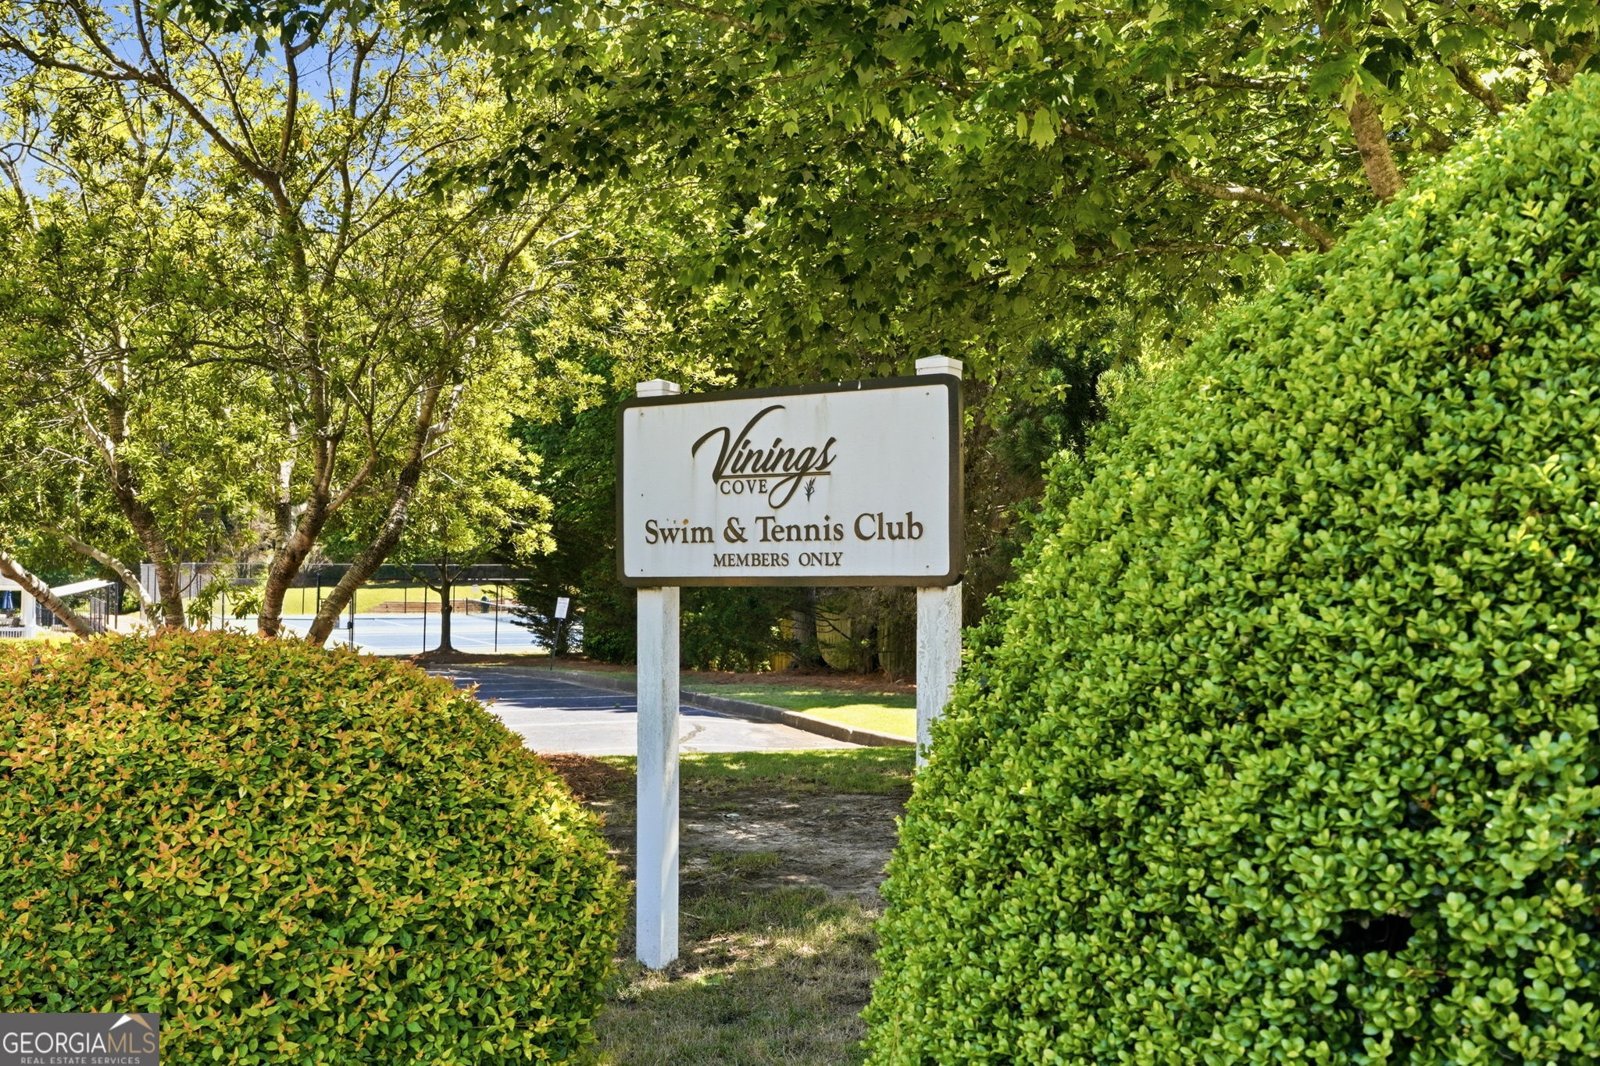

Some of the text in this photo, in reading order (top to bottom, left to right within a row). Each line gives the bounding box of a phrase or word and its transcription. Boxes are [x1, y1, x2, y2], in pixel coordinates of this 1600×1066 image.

[691, 404, 837, 509] Vinings
[720, 479, 768, 495] COVE
[644, 511, 924, 545] Swim & Tennis Club
[713, 551, 844, 567] MEMBERS ONLY
